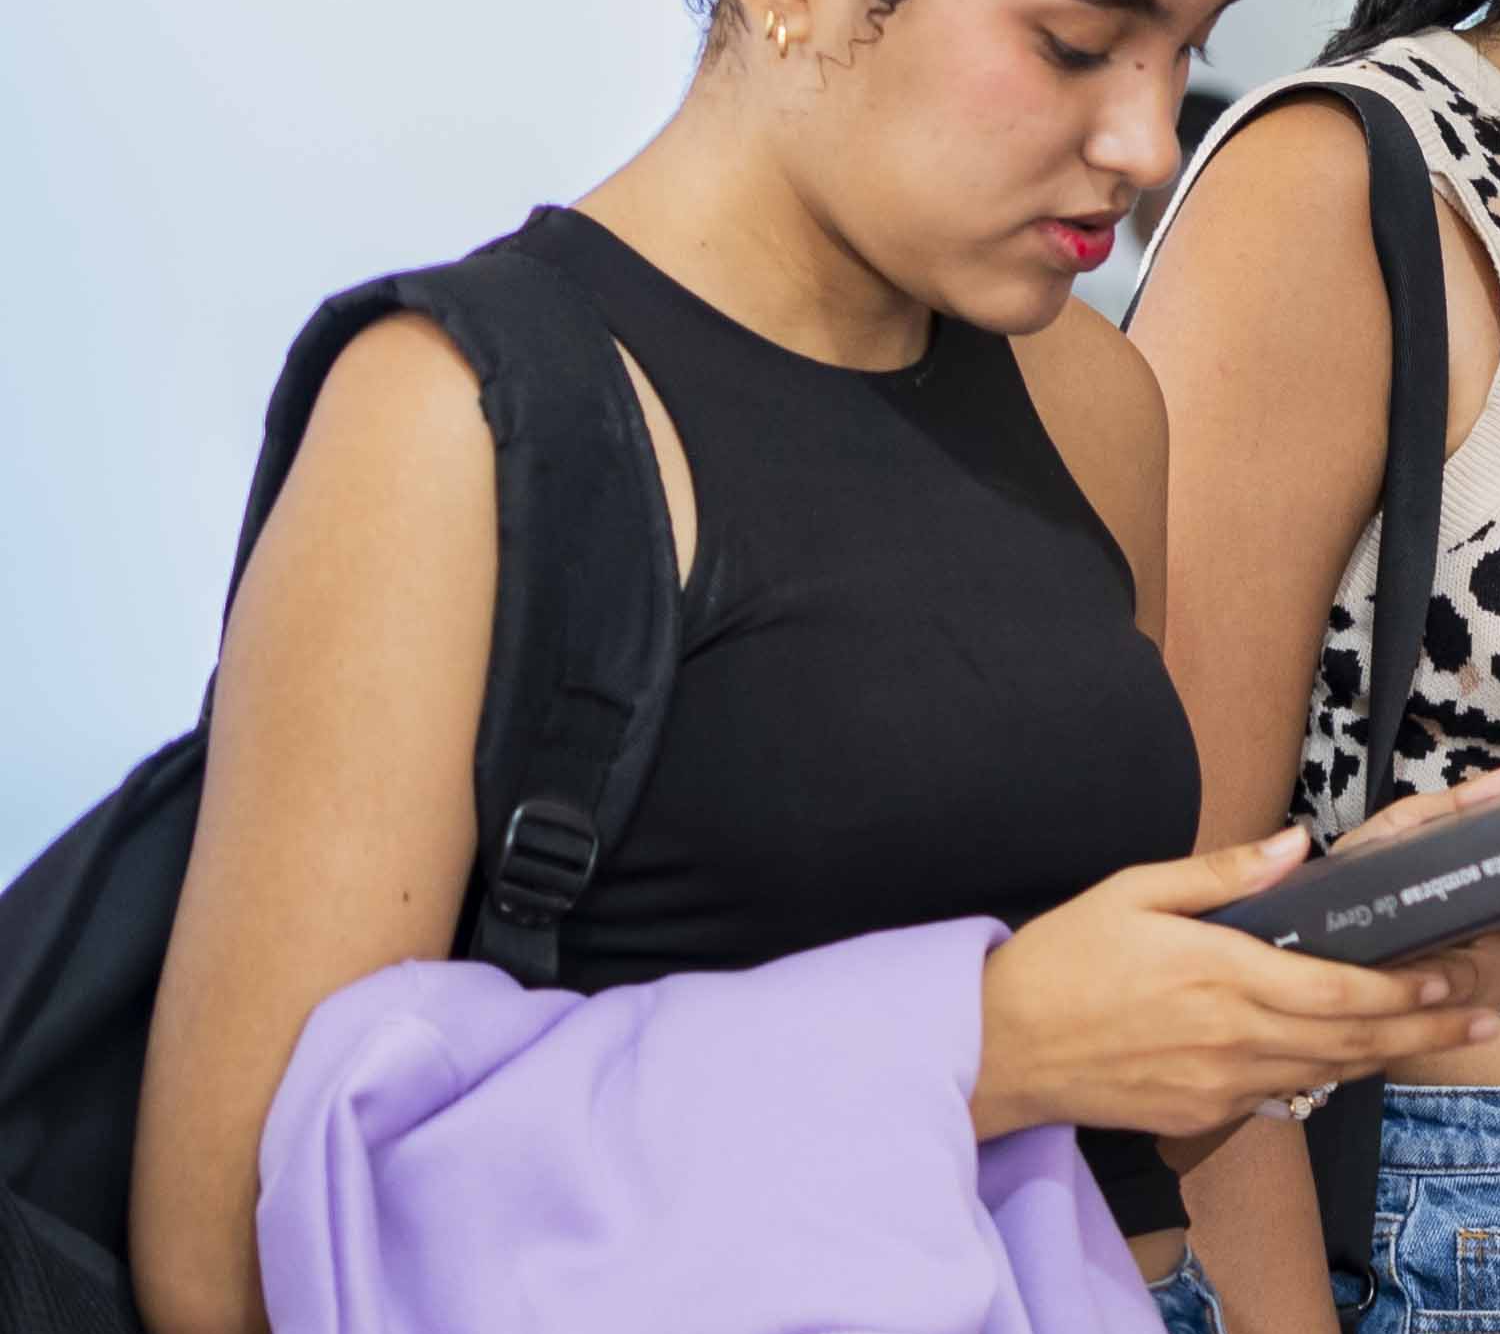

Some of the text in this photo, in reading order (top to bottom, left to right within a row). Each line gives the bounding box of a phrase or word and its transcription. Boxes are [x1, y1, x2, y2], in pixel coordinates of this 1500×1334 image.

[1400, 863, 1482, 907] sombras
[1326, 904, 1374, 933] Grey
[1372, 896, 1399, 919] de
